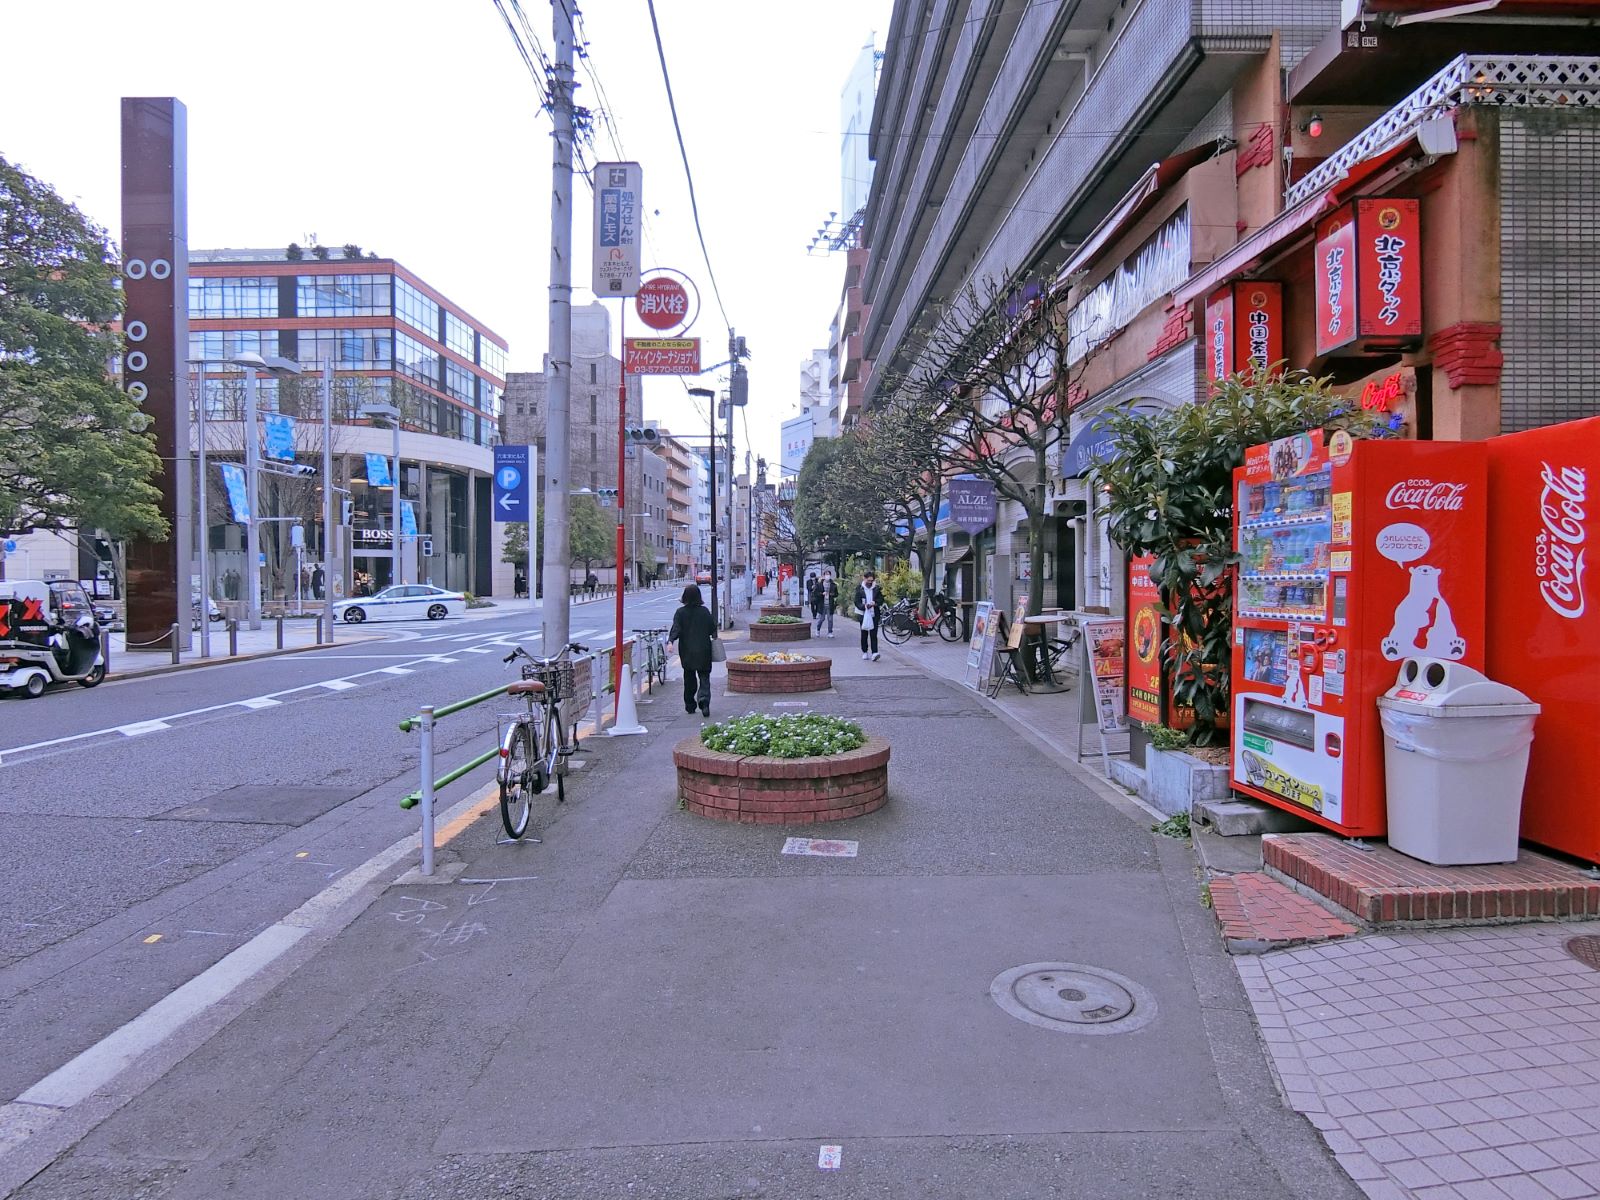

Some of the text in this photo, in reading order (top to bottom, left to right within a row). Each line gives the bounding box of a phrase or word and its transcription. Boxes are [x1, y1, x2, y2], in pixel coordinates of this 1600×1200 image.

[1362, 36, 1378, 47] BNE
[1374, 234, 1405, 326] 北京ダック
[1326, 247, 1344, 336] 北京ダック
[641, 293, 684, 314] 消火栓
[957, 495, 988, 505] ALZE
[1385, 481, 1468, 510] Coca-Cola
[362, 529, 394, 539] BOSS
[1540, 461, 1585, 619] Coca-Cola
[1143, 692, 1159, 704] OPEN
